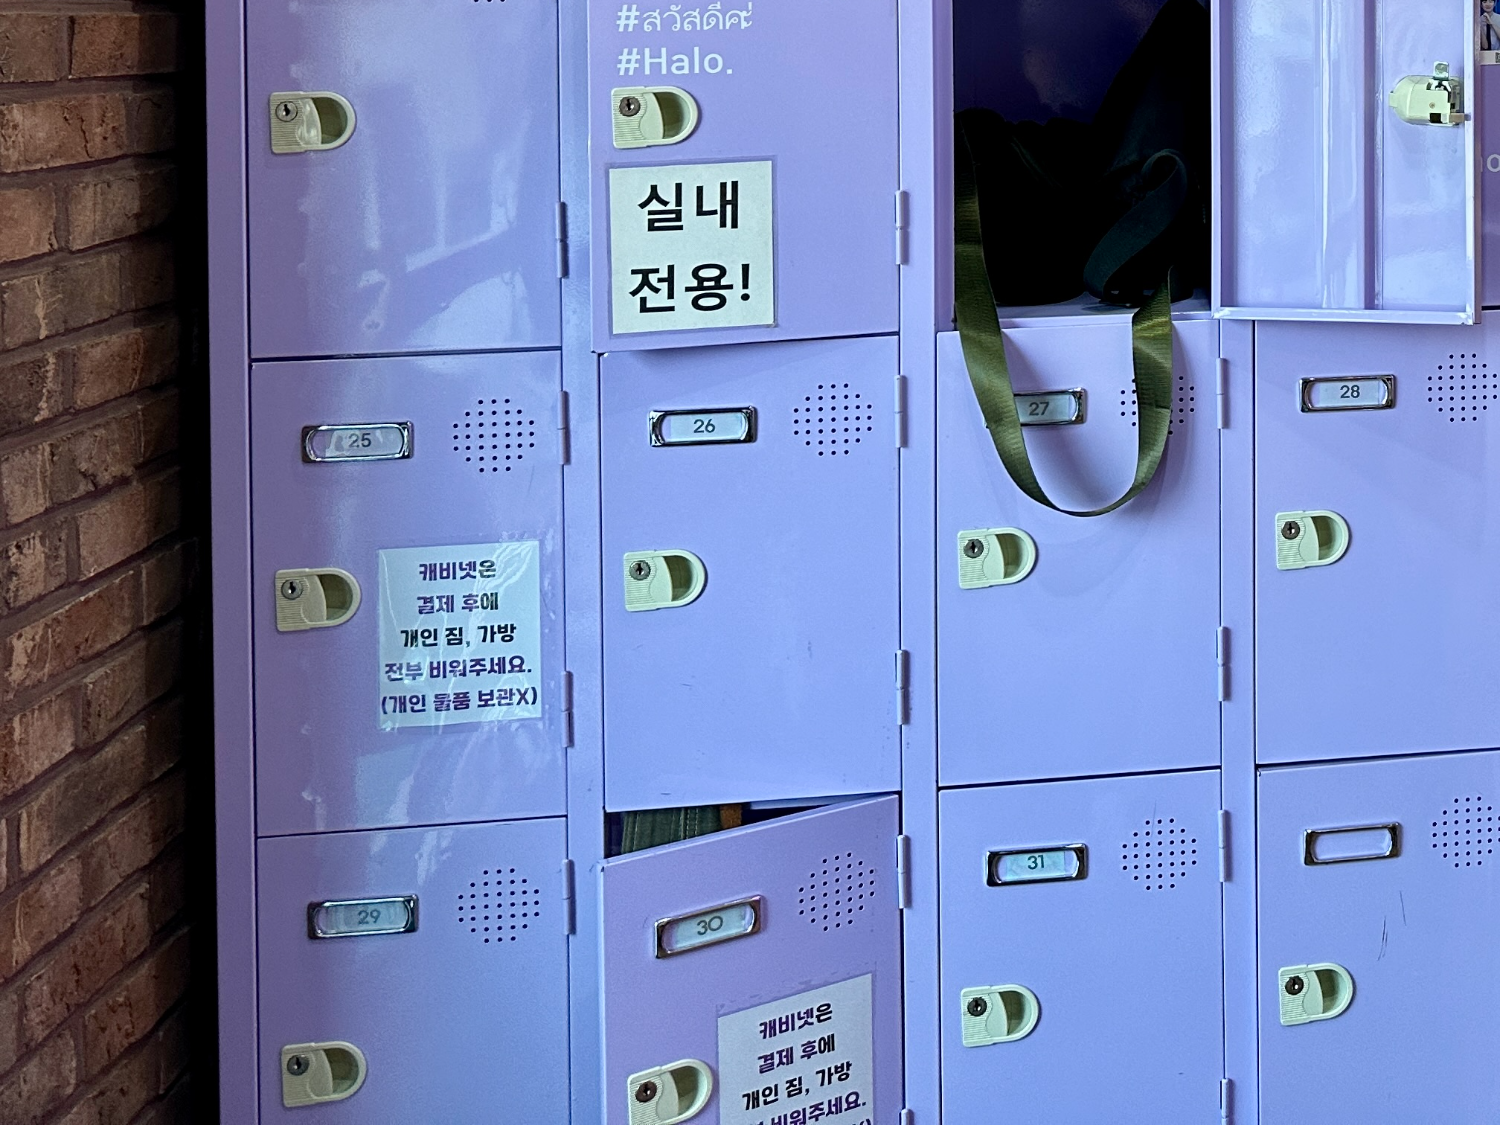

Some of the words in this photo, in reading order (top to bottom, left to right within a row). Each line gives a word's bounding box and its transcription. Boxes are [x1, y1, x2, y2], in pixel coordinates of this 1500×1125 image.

[616, 46, 732, 75] #Halo.
[637, 179, 740, 231] 실내
[628, 262, 751, 313] 전용!
[1339, 384, 1360, 398] 28
[1029, 402, 1049, 416] 27
[693, 419, 715, 433] 26
[348, 433, 371, 448] 25
[419, 559, 497, 581] 캐비넷은
[417, 594, 455, 615] 결제
[461, 591, 499, 612] 후에
[400, 628, 438, 648] 개인
[445, 626, 471, 648] 짐,
[477, 623, 517, 643] 가방
[384, 661, 424, 682] 전부
[429, 655, 532, 679] 비워주세요.
[381, 694, 426, 714] (개인
[433, 691, 471, 712] 물품
[477, 686, 538, 709] 보관X)
[1027, 855, 1045, 870] 31
[357, 909, 381, 925] 29
[697, 916, 723, 936] 30
[759, 1002, 833, 1039] 캐비넷은
[757, 1046, 794, 1074] 결제
[800, 1033, 835, 1060] 후에
[742, 1083, 779, 1110] 개인
[785, 1076, 810, 1098] 짐,
[815, 1061, 852, 1087] 가방
